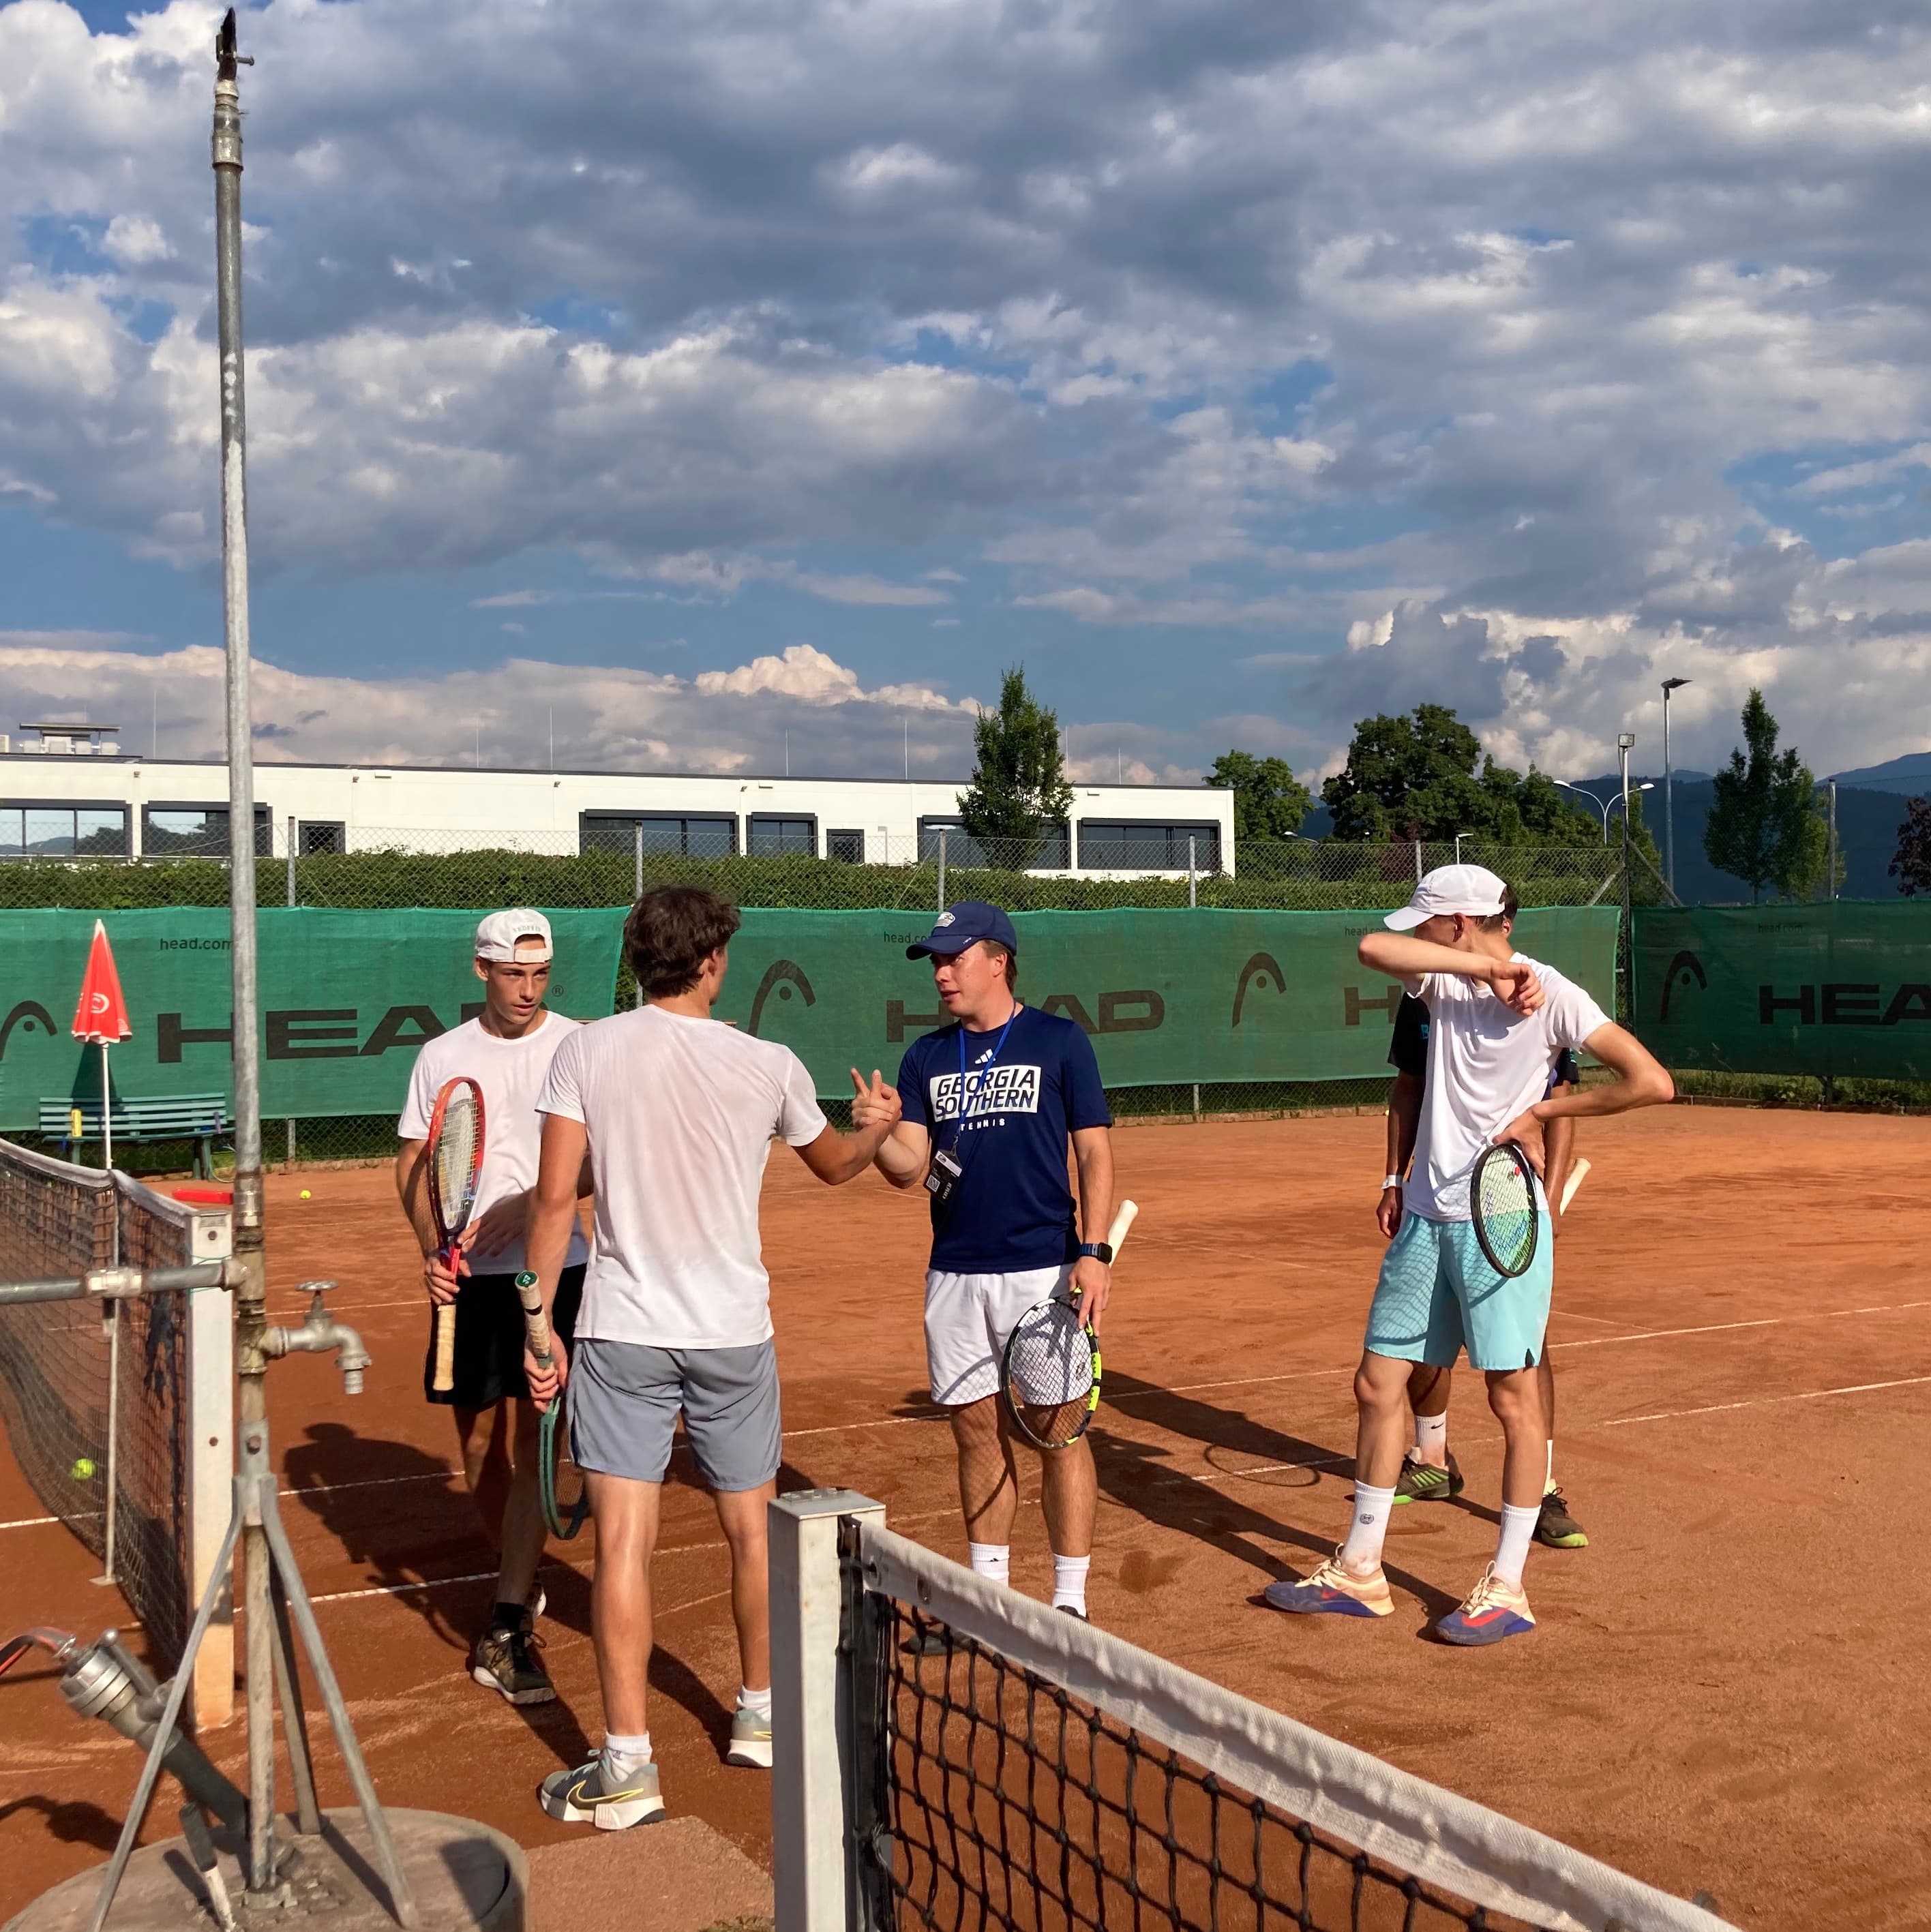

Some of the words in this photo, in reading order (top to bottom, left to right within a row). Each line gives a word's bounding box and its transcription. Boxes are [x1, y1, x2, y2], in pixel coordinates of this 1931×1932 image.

[884, 931, 930, 944] head.co
[886, 990, 1165, 1043] HAD
[937, 1068, 1036, 1098] GEORGIA
[935, 1089, 1035, 1118] SOUTHERN
[960, 1118, 1006, 1132] TENNIS
